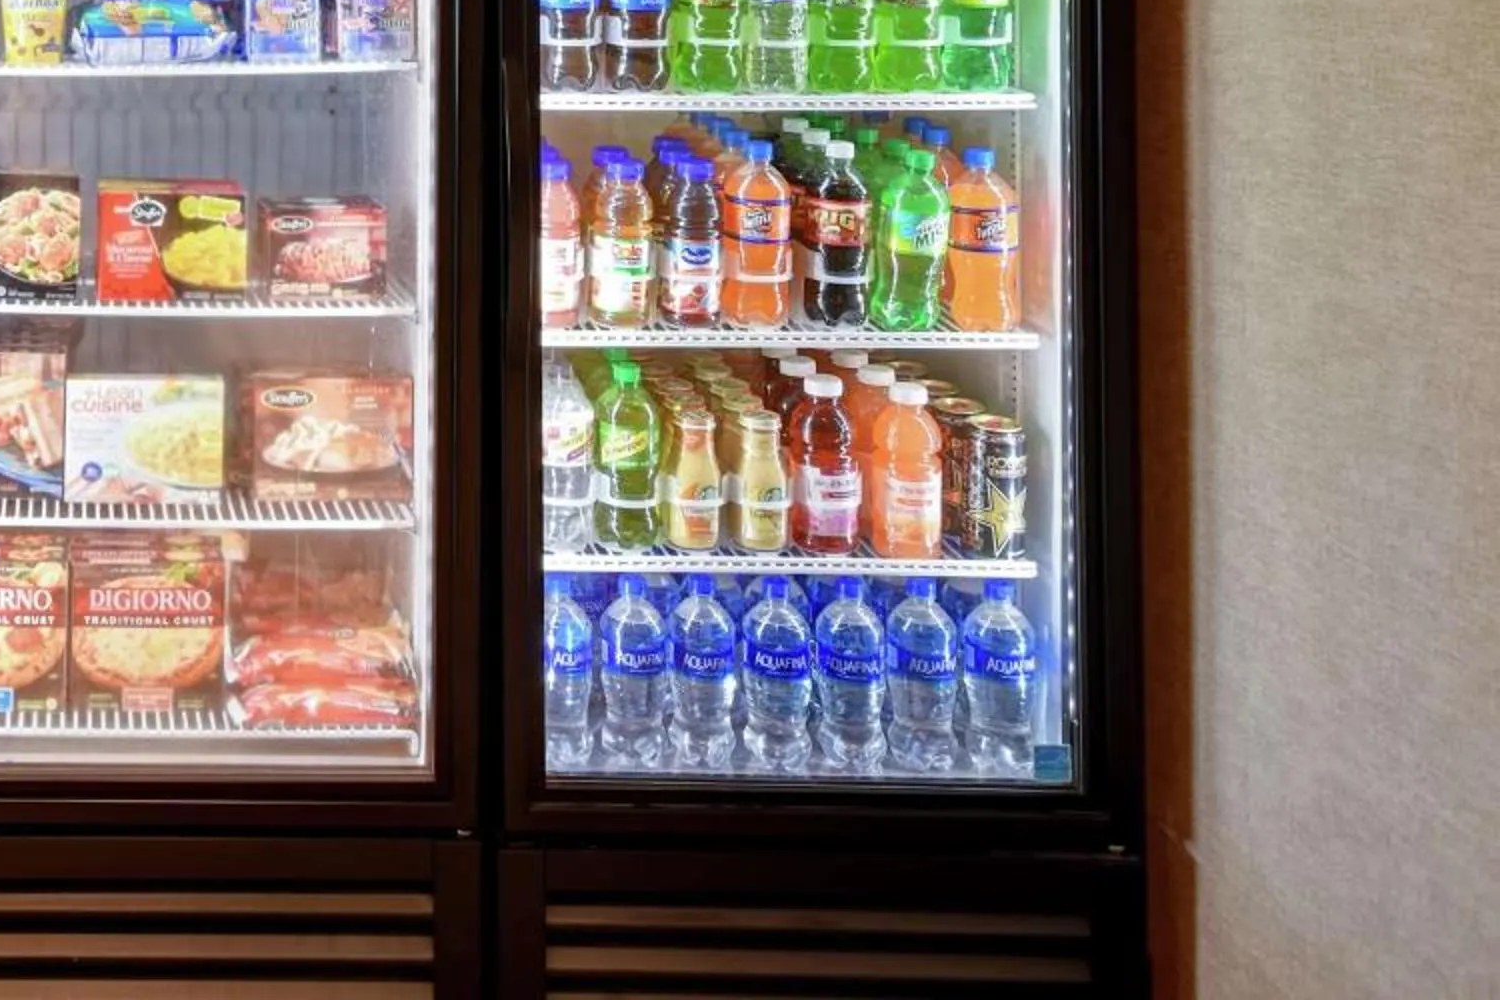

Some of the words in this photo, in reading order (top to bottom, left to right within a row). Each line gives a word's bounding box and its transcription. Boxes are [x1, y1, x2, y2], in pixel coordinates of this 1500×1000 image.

[90, 588, 212, 610] DIGIORNO
[14, 614, 55, 625] CRUST
[84, 615, 169, 625] TRADITIONAL
[174, 615, 214, 626] CRUST
[616, 652, 663, 668] AQUAFIN
[684, 653, 727, 669] AQUAFIN
[755, 652, 808, 668] AQUAFINA
[909, 657, 957, 675] AQUAFIN
[986, 656, 1036, 675] AQUAFIN
